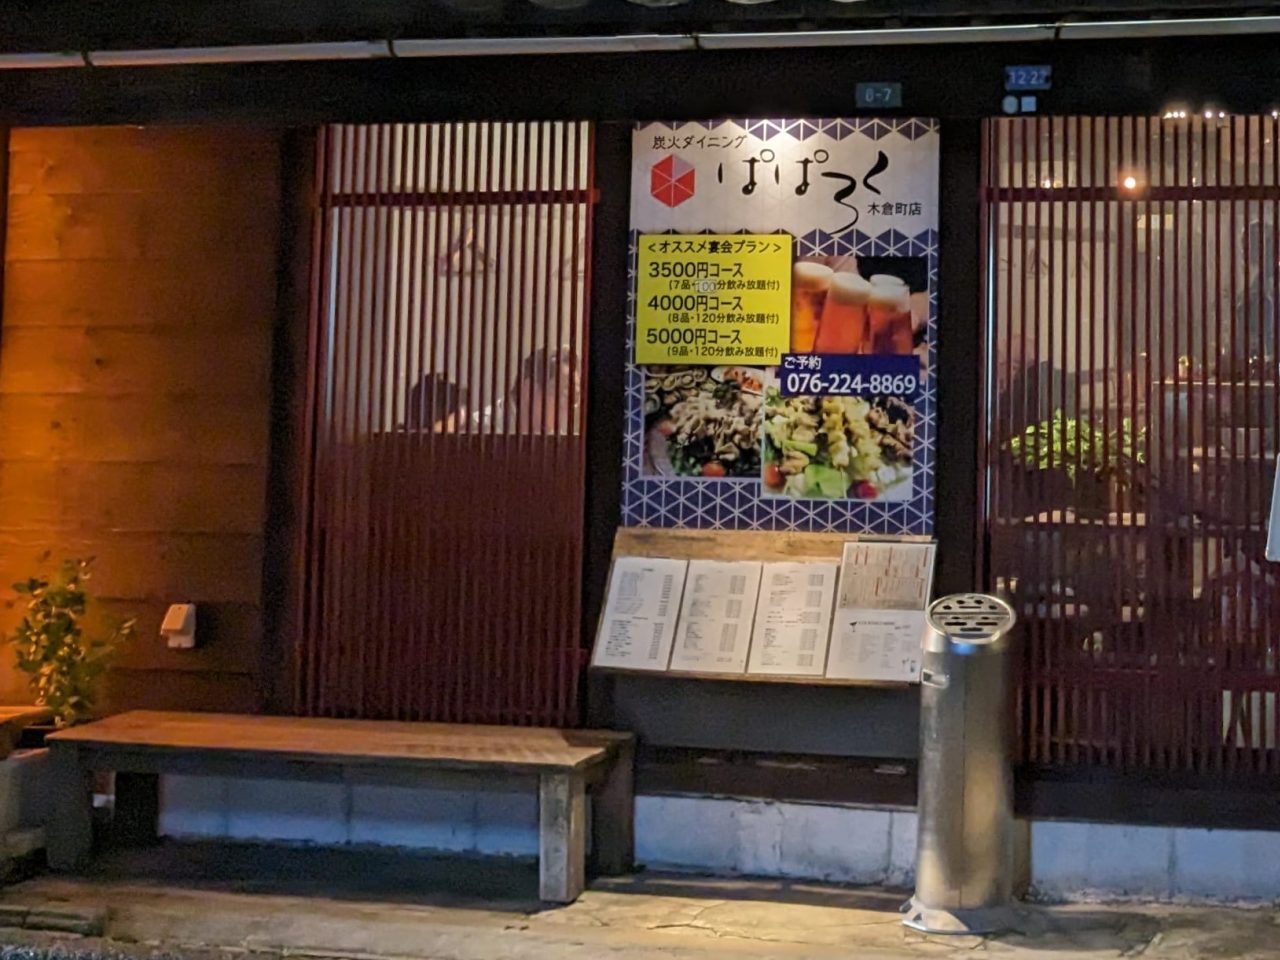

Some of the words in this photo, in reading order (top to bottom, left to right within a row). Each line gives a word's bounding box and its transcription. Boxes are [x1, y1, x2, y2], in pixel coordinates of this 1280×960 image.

[652, 134, 747, 150] 炭火ダイニング
[867, 202, 922, 216] 木倉町店
[649, 261, 744, 279] 3500円コース
[647, 295, 743, 312] 4000円コース
[646, 328, 742, 345] 5000円コース
[784, 355, 822, 370] ご予約
[787, 373, 917, 395] 076-224-8869
